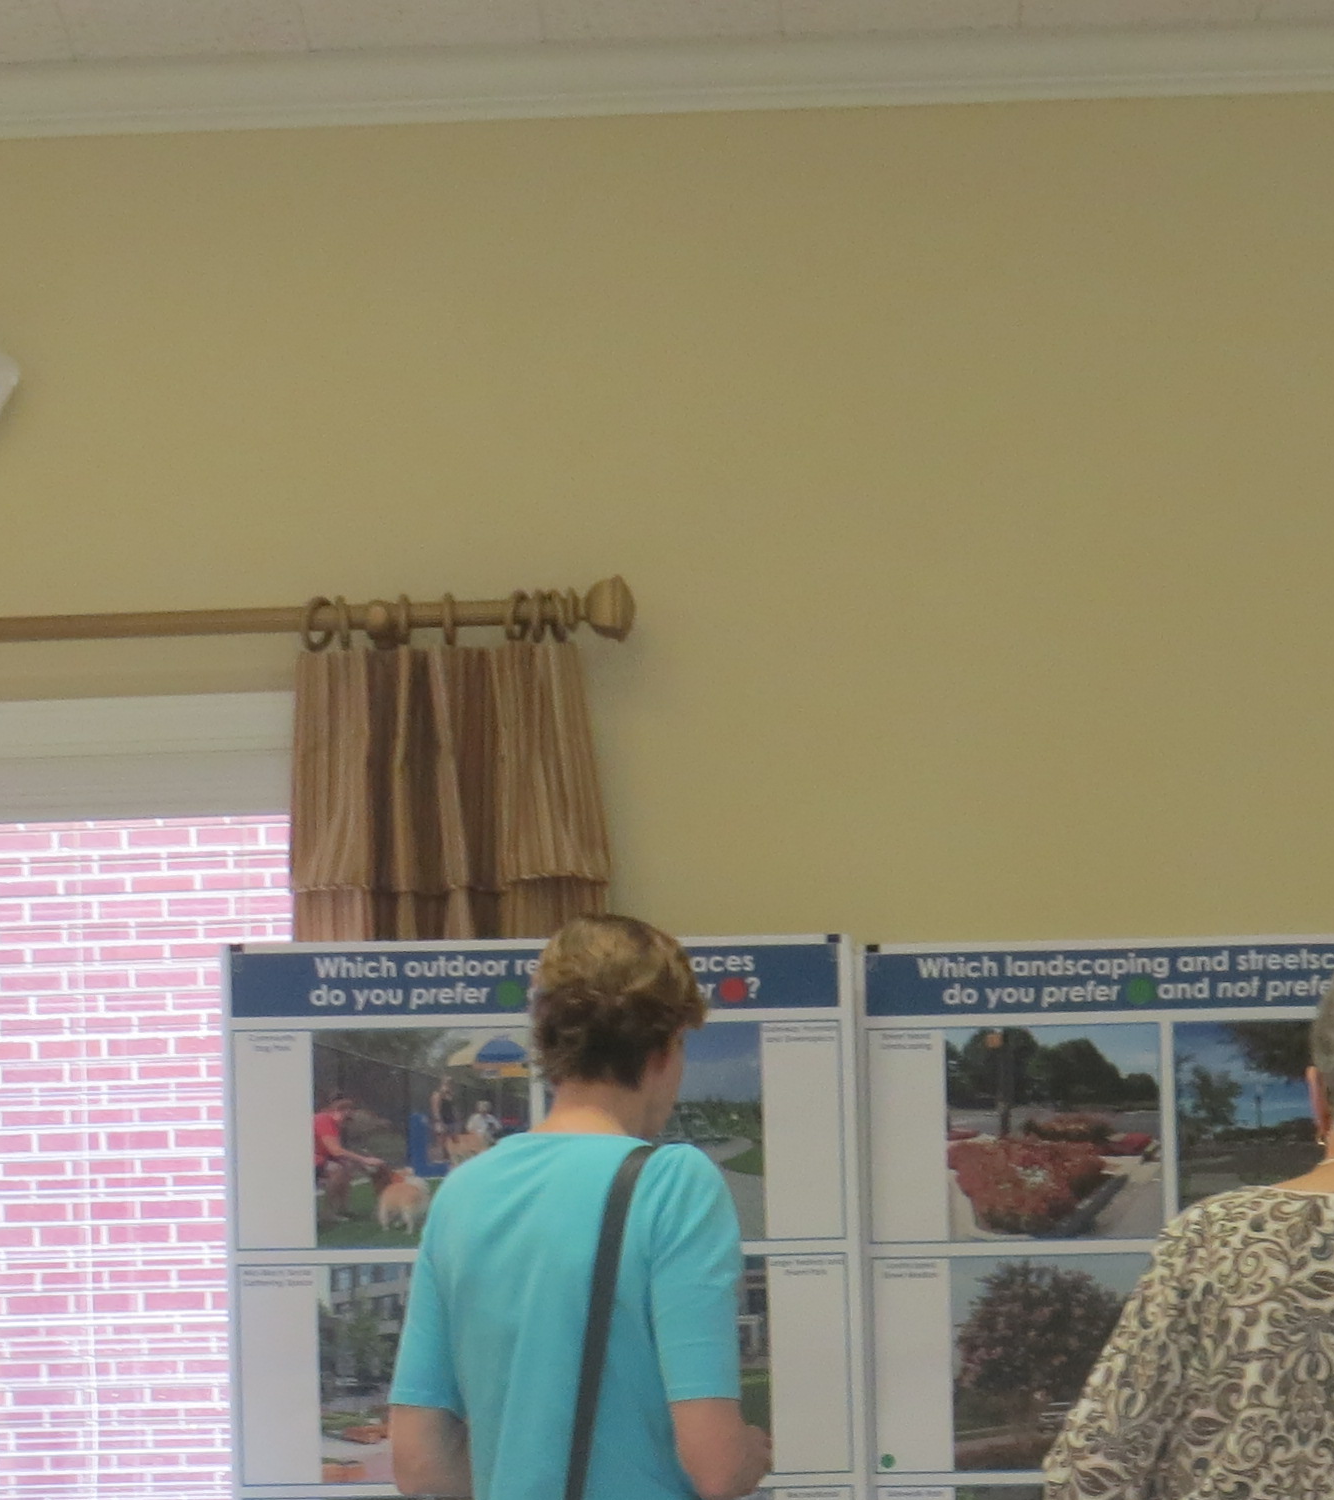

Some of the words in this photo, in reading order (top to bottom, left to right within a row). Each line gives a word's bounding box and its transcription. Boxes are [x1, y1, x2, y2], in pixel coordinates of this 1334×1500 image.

[314, 956, 398, 979] Which
[403, 955, 509, 978] outdoor
[690, 954, 756, 973] aces
[918, 956, 999, 979] Which
[1006, 952, 1169, 980] landscaping
[1176, 950, 1230, 972] and
[309, 984, 347, 1006] do
[353, 987, 403, 1011] you
[409, 982, 490, 1010] prefer
[943, 983, 979, 1005] do
[985, 986, 1035, 1008] you
[1041, 980, 1122, 1008] prefer
[1158, 976, 1210, 999] and
[1218, 976, 1261, 998] not
[1267, 974, 1333, 1001] prefe
